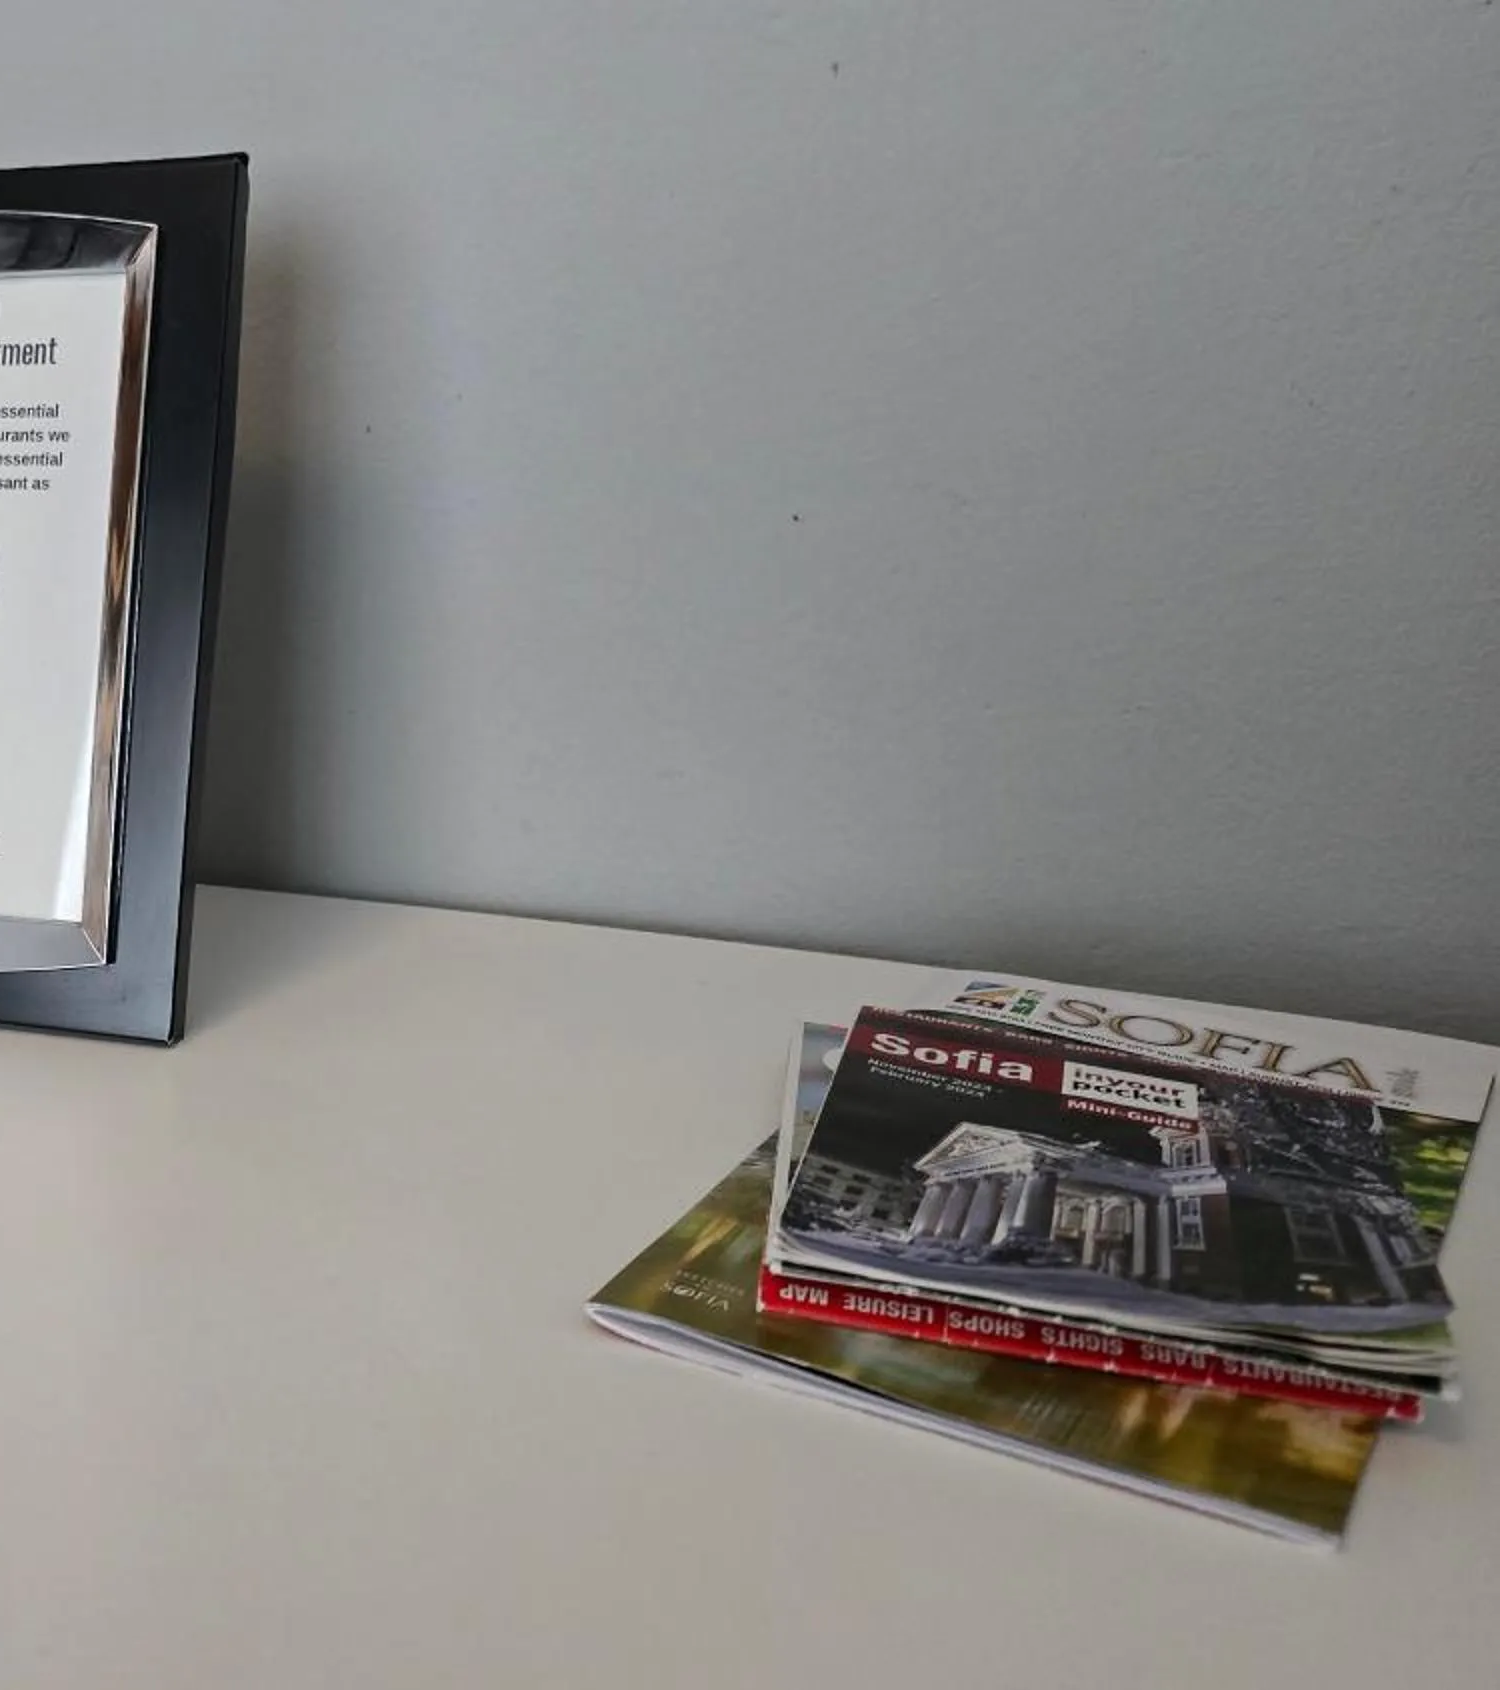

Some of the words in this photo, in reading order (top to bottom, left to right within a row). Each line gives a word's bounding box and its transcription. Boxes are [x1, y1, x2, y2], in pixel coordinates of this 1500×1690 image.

[47, 430, 71, 443] we
[31, 478, 51, 492] as
[870, 1032, 1034, 1083] Sofia
[1047, 998, 1381, 1093] SOFIA
[867, 1056, 949, 1083] November
[869, 1065, 942, 1089] February
[1073, 1068, 1185, 1098] inyour
[1072, 1080, 1186, 1110] pocket
[1067, 1100, 1193, 1130] Mini-Guide
[779, 1283, 829, 1307] MAP
[842, 1293, 935, 1324] LEISURE
[949, 1310, 1026, 1340] SHOPS
[1041, 1325, 1124, 1357] SIGHTS
[1140, 1343, 1205, 1370] BARS
